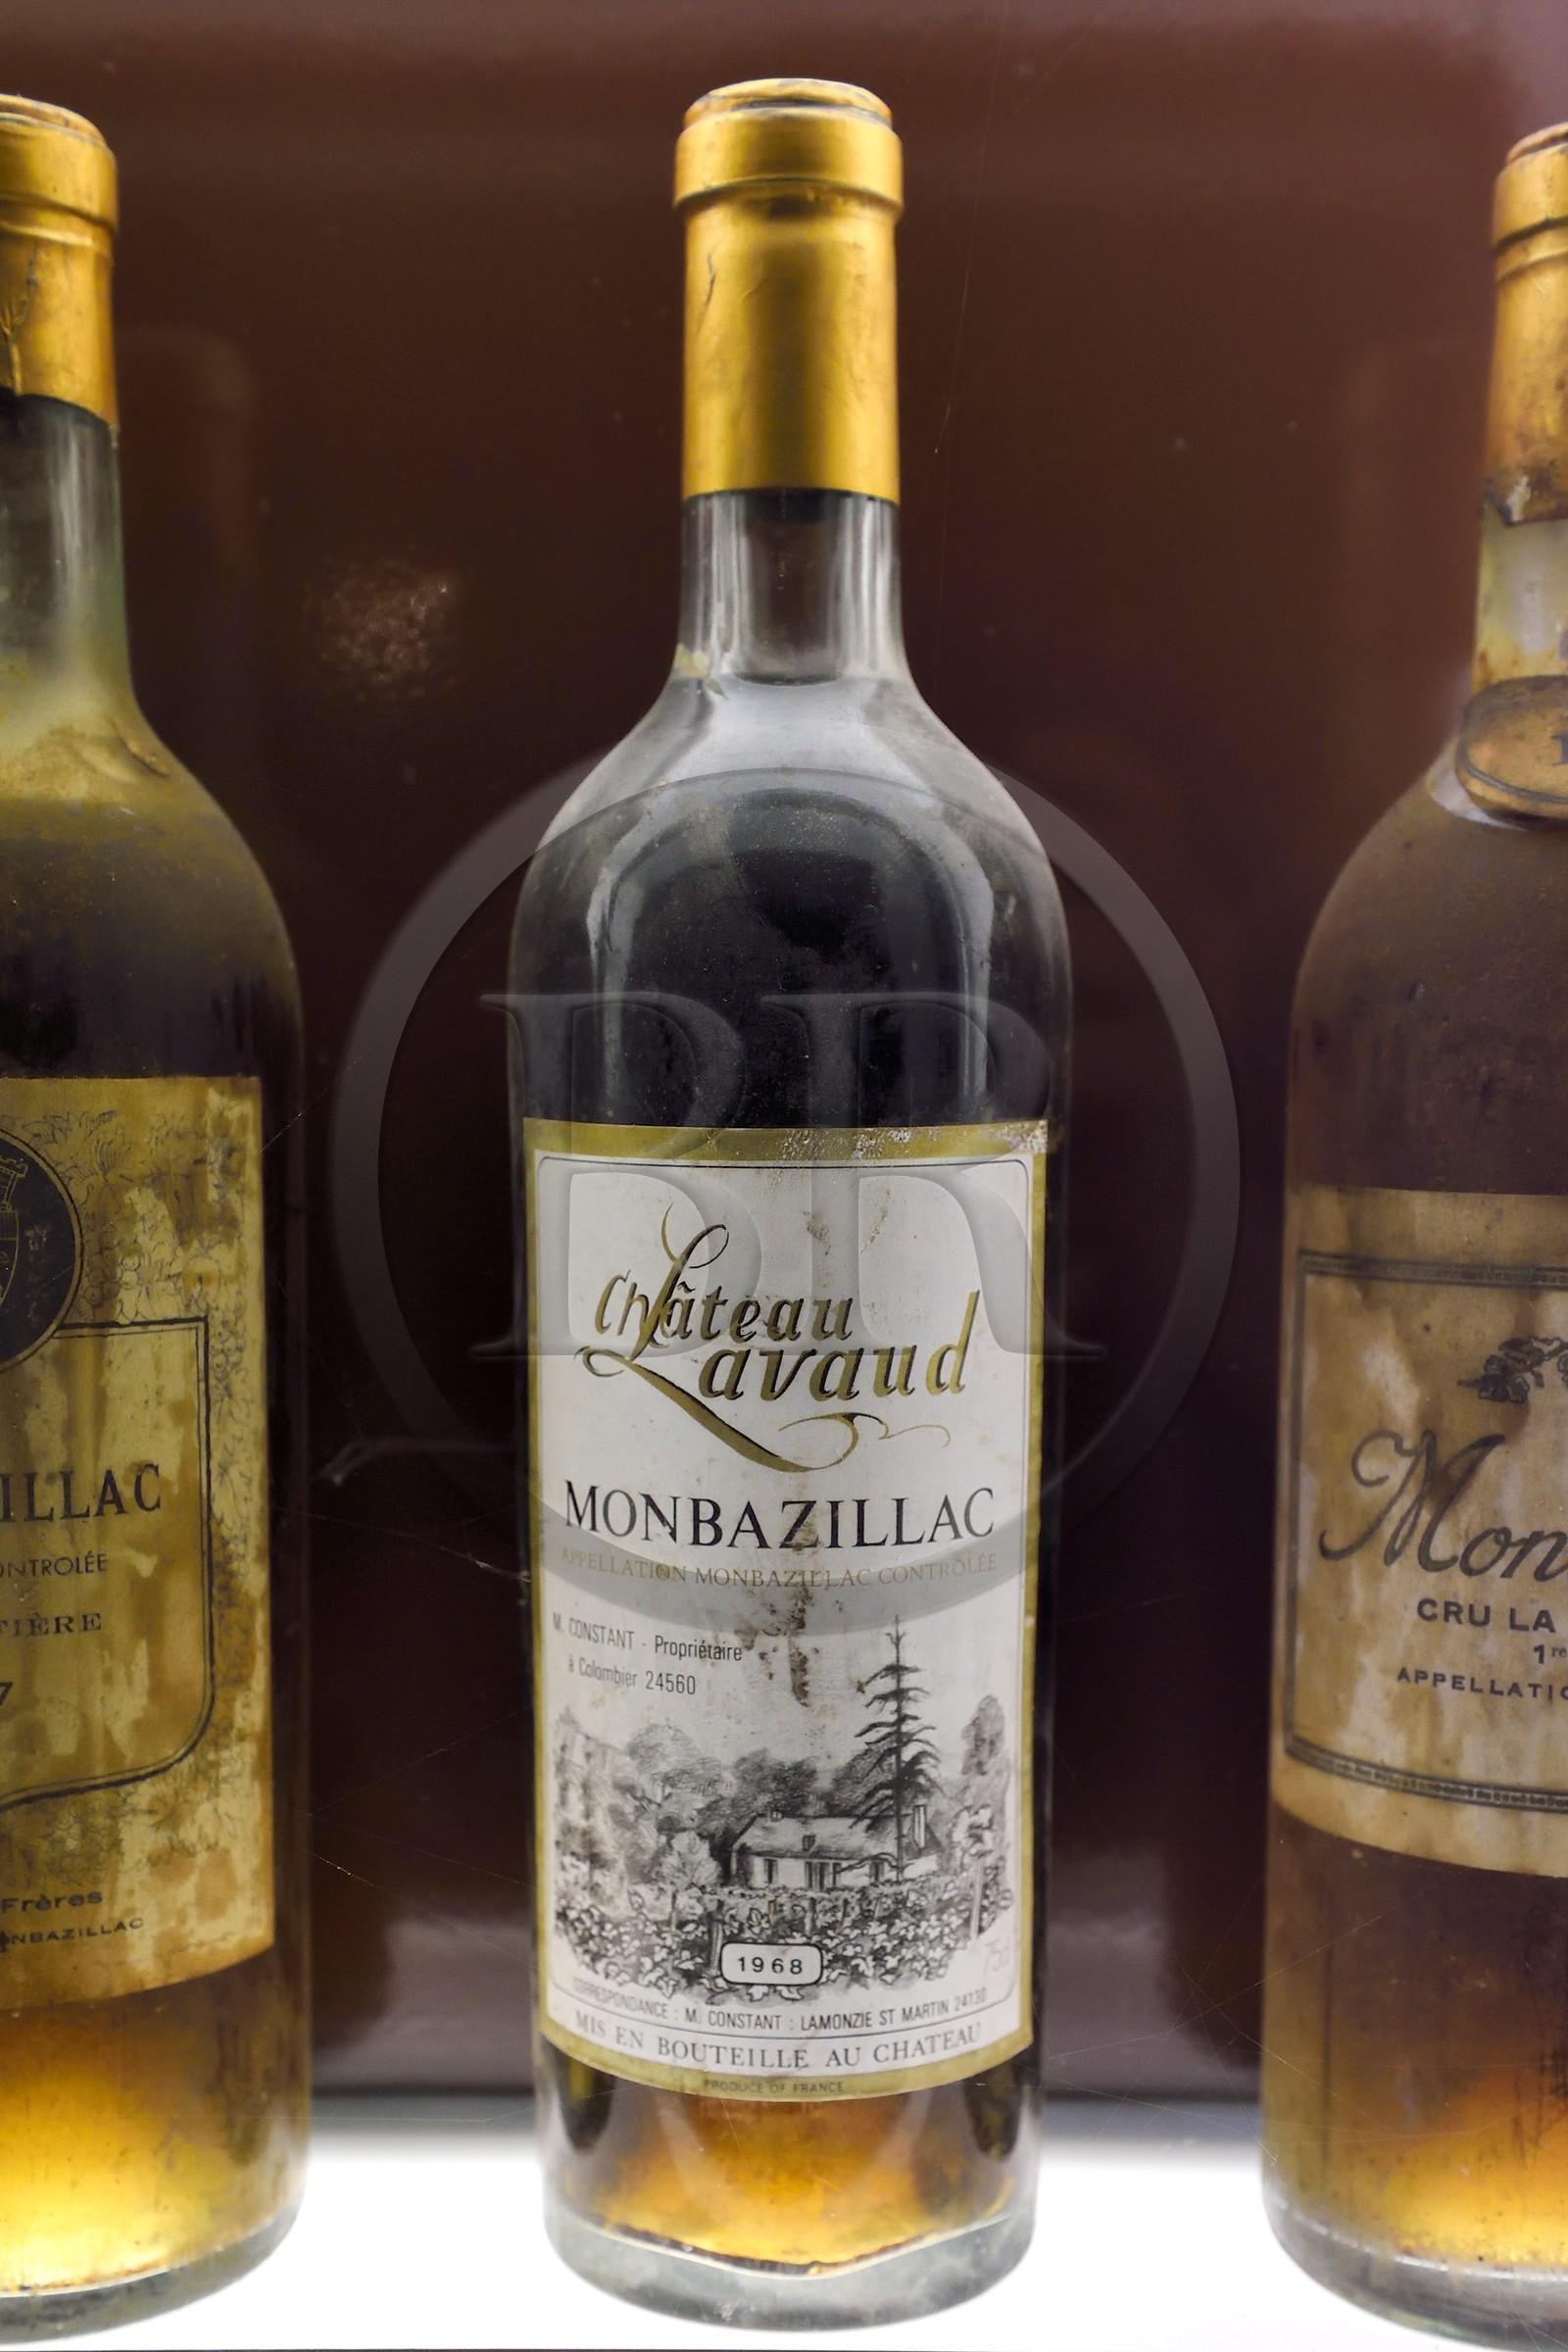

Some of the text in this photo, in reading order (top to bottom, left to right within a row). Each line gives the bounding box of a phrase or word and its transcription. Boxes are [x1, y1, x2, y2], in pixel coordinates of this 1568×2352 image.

[564, 1480, 995, 1550] MONBAZILLAC
[1319, 1429, 1568, 1582] Mon
[560, 1545, 686, 1583] APPELLATION
[695, 1567, 871, 1589] MONBAZILLAC
[1417, 1597, 1556, 1634] CRU LA
[568, 1617, 635, 1650] CONSTANT
[654, 1635, 743, 1661] Propriétaire
[578, 1656, 637, 1688] Colombier
[646, 1670, 696, 1695] 24560
[0, 1891, 103, 1912] Frères
[0, 1917, 143, 1951] NBAZILLAC
[737, 1956, 803, 1975] 1968
[685, 2007, 702, 2025] M.
[708, 2009, 782, 2031] CONSTANT
[801, 2011, 872, 2032] LAMONZIE
[879, 2008, 896, 2027] ST
[901, 1999, 950, 2023] MARTIN
[575, 2009, 982, 2069] MIS EN BOUTEILLE AU CHATEAU
[703, 2079, 845, 2094] PRODUCE OF FRANCE
